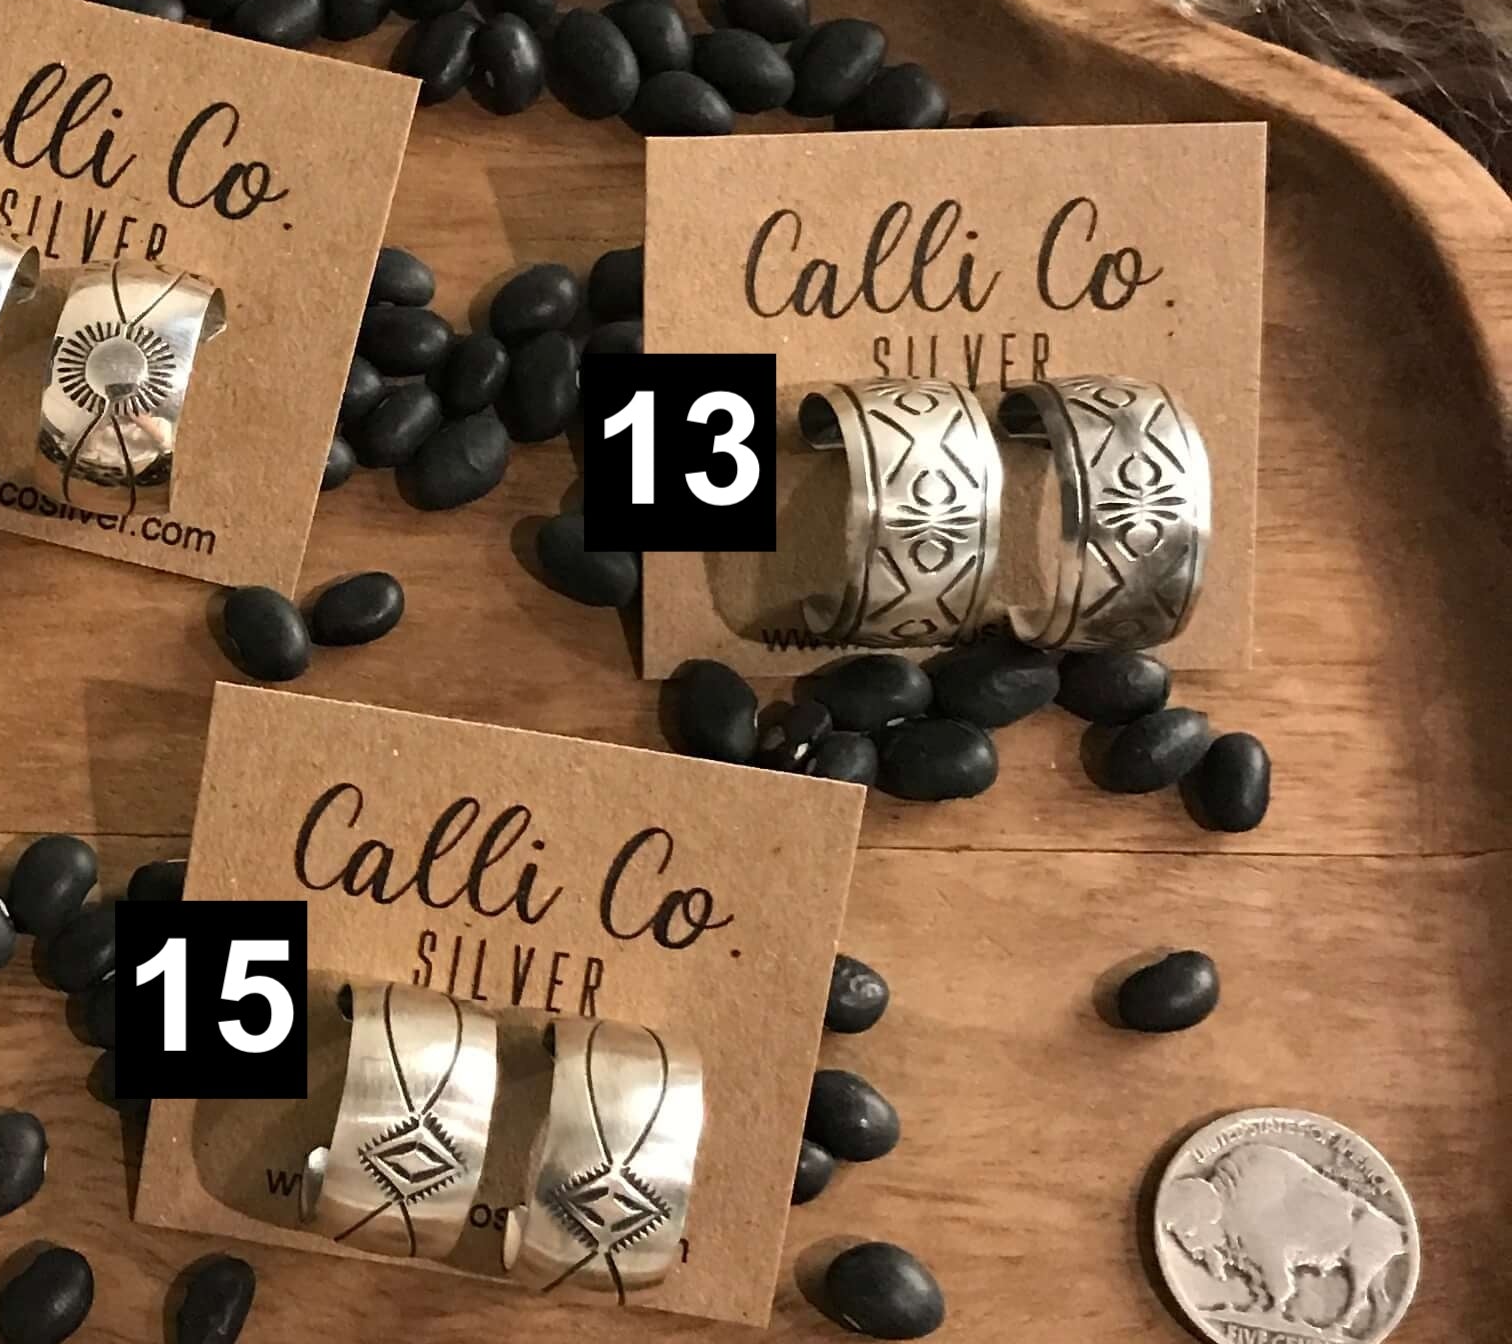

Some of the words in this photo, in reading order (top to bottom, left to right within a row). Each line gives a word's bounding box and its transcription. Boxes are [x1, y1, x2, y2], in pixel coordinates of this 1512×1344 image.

[166, 100, 295, 233] Co.
[0, 187, 168, 265] SILVER
[743, 198, 1003, 321] Calli
[1035, 195, 1178, 313] Co.
[873, 332, 1050, 393] SILVER
[293, 782, 565, 925] Calli
[598, 826, 743, 960] Co.
[412, 929, 604, 1017] SILVER
